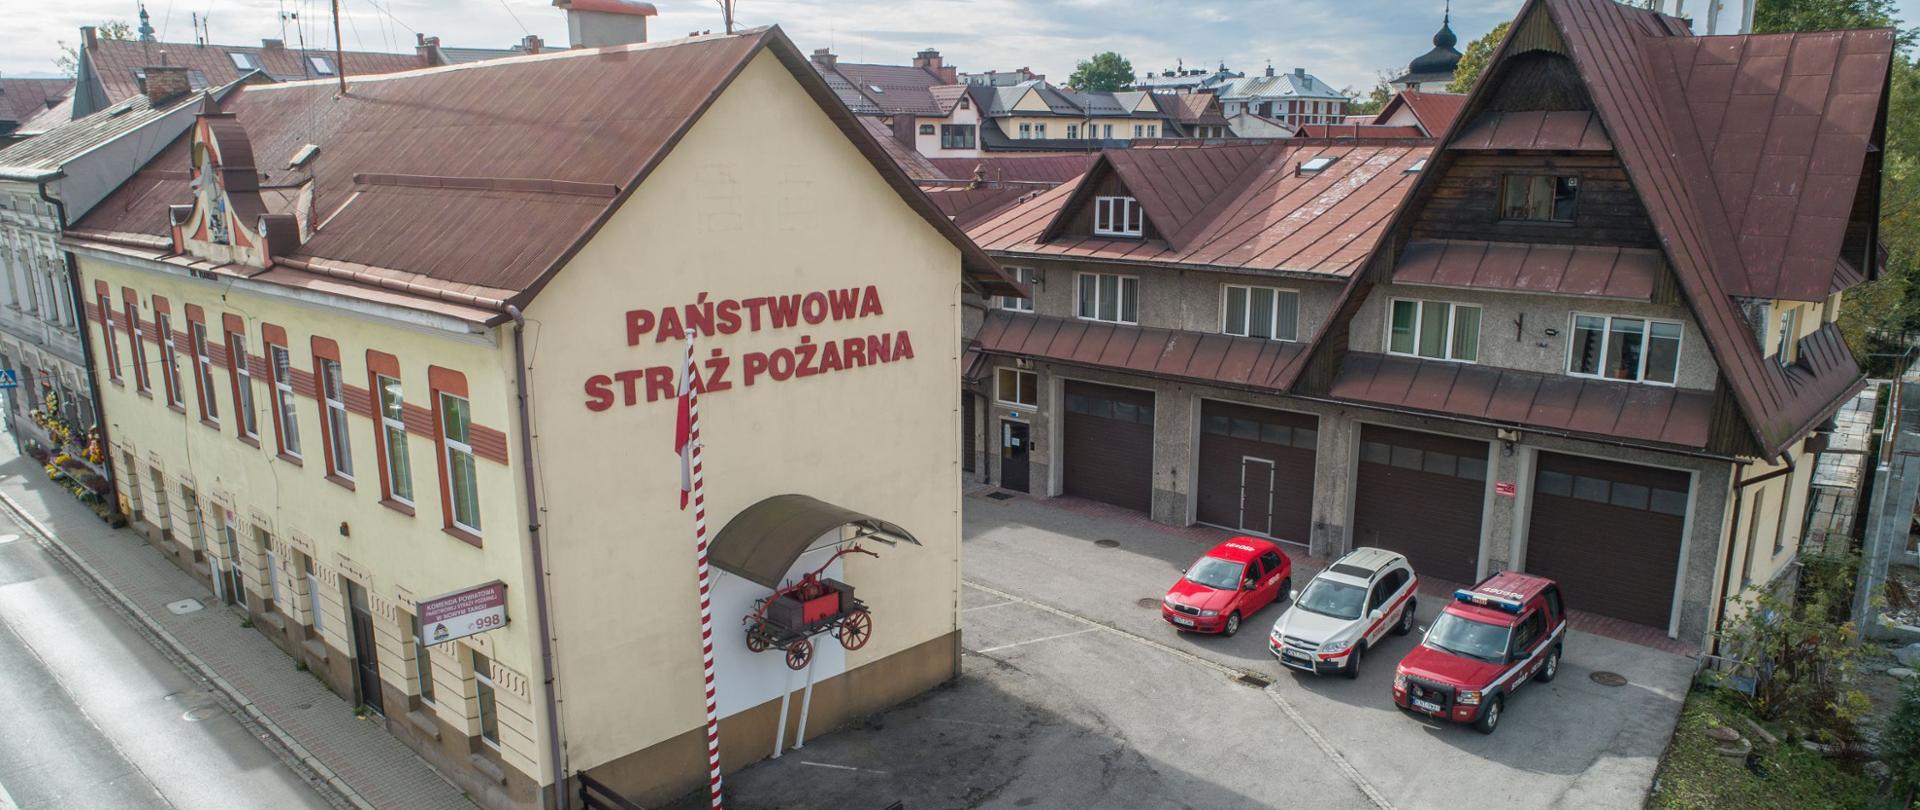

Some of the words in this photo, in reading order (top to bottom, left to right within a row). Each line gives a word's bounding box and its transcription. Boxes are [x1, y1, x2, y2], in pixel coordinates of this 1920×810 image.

[626, 285, 883, 346] PAŃSTWOWA
[744, 330, 914, 386] POŻARNA
[426, 598, 457, 611] KOMENDA
[458, 588, 495, 603] POWIATOWA
[476, 614, 500, 629] 998
